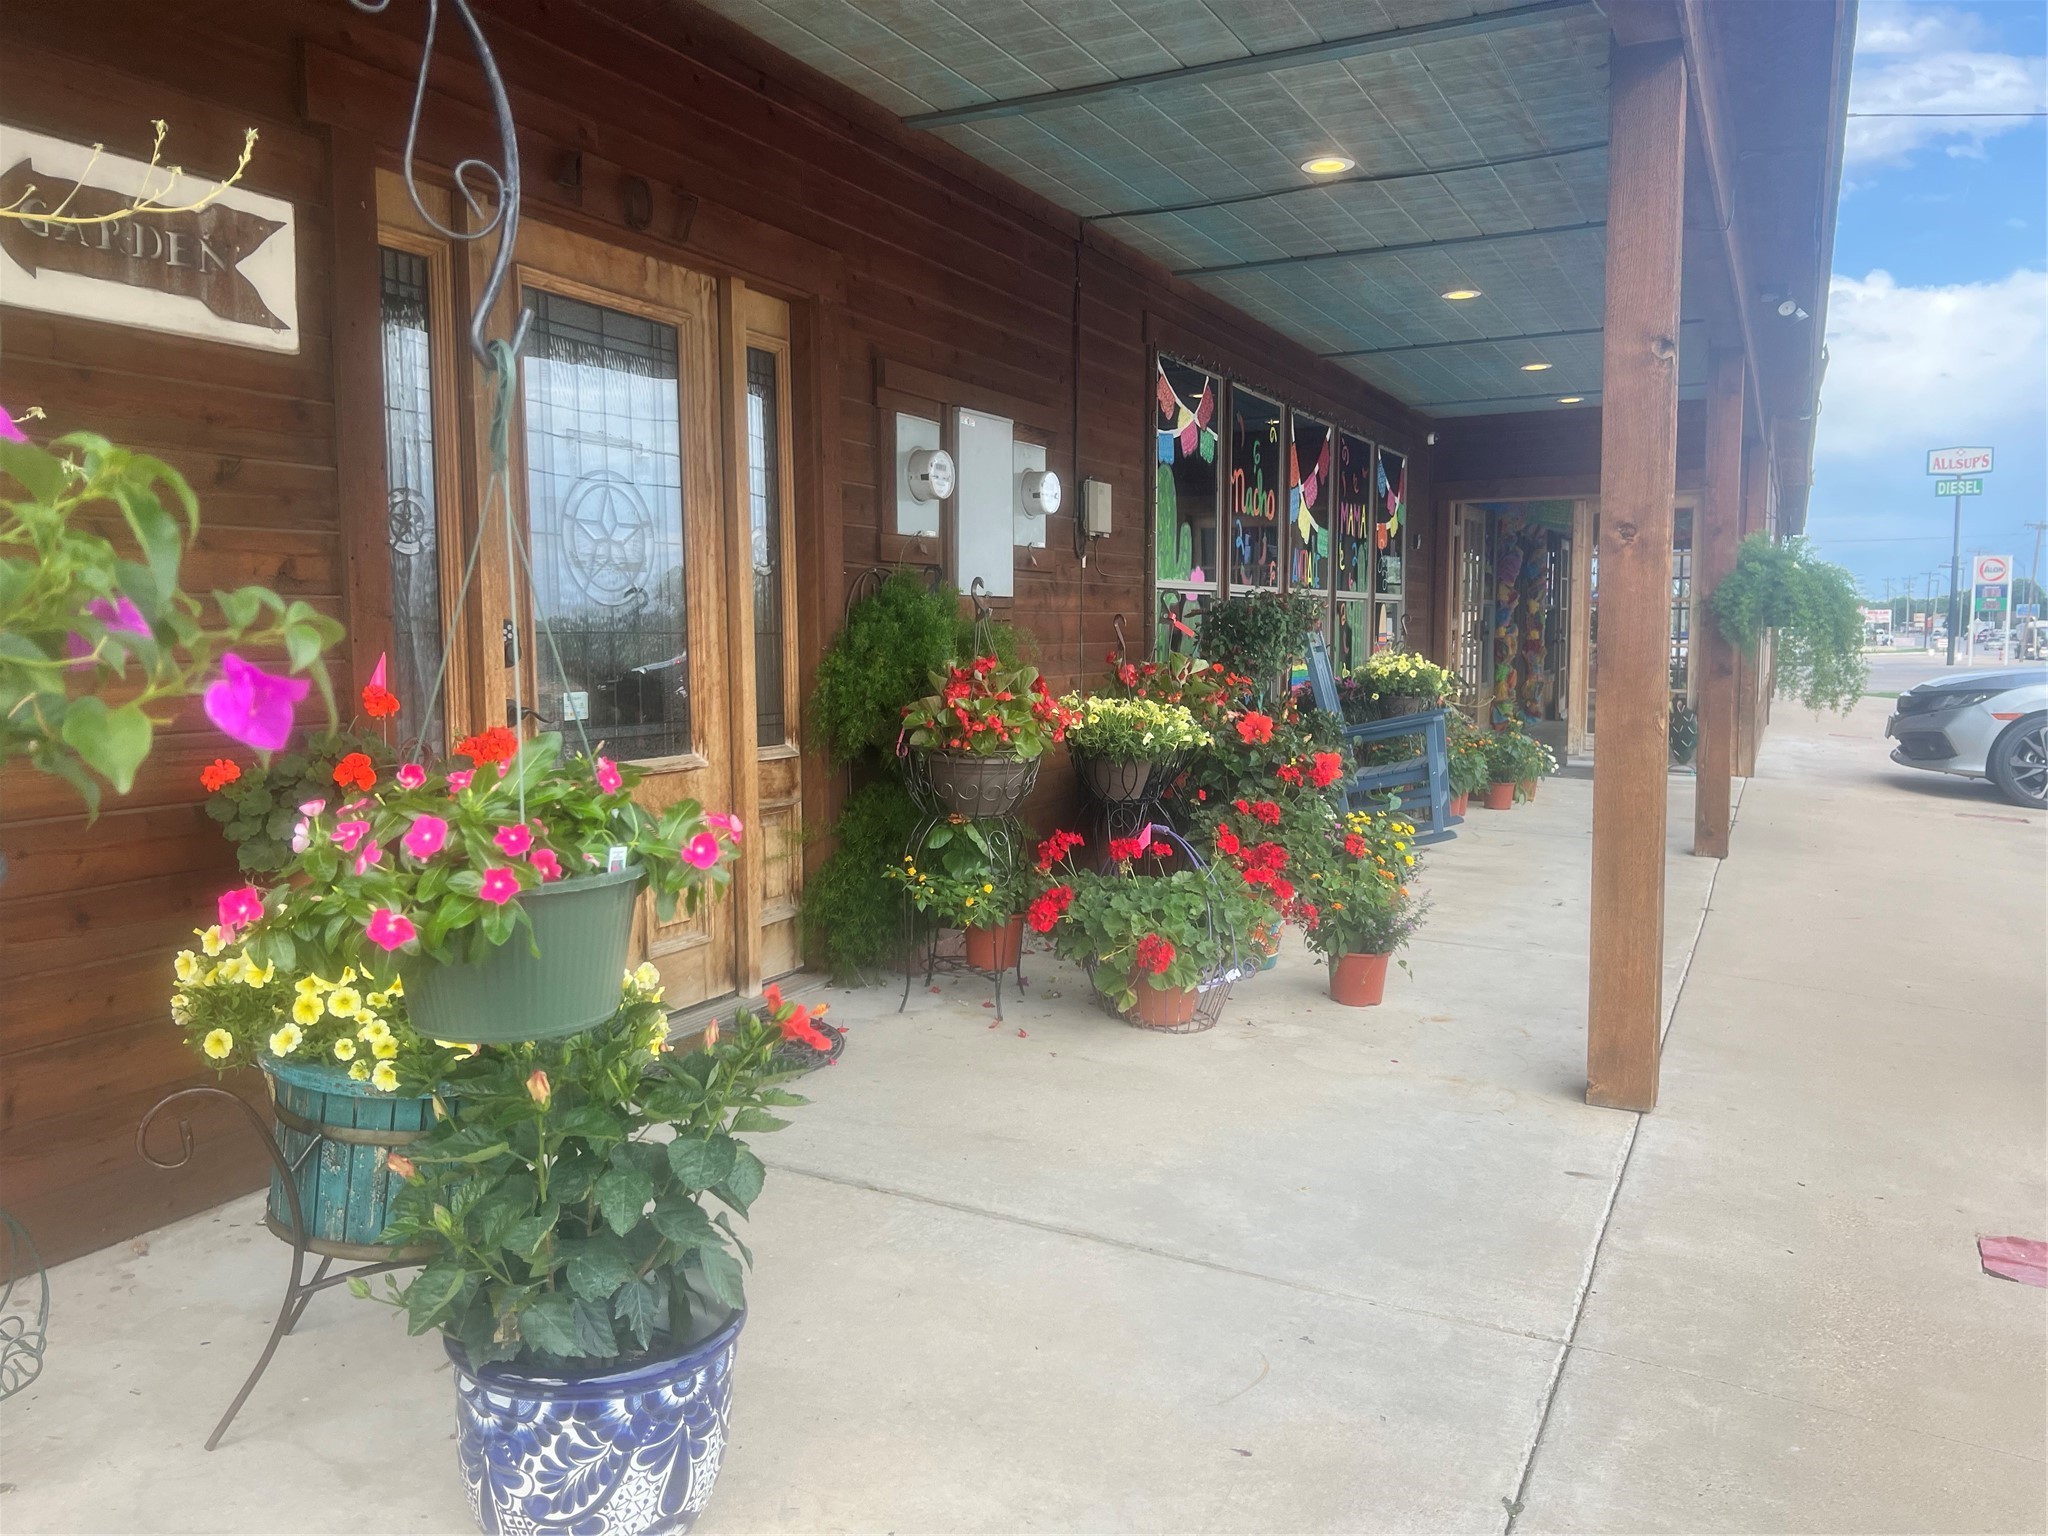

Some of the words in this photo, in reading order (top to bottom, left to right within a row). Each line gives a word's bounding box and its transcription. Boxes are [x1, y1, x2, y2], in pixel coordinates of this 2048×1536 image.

[19, 198, 228, 274] GARDEN
[1932, 454, 1990, 471] ALLSUP'S
[1937, 480, 1981, 495] DIESEL
[1340, 502, 1367, 539] MAMA
